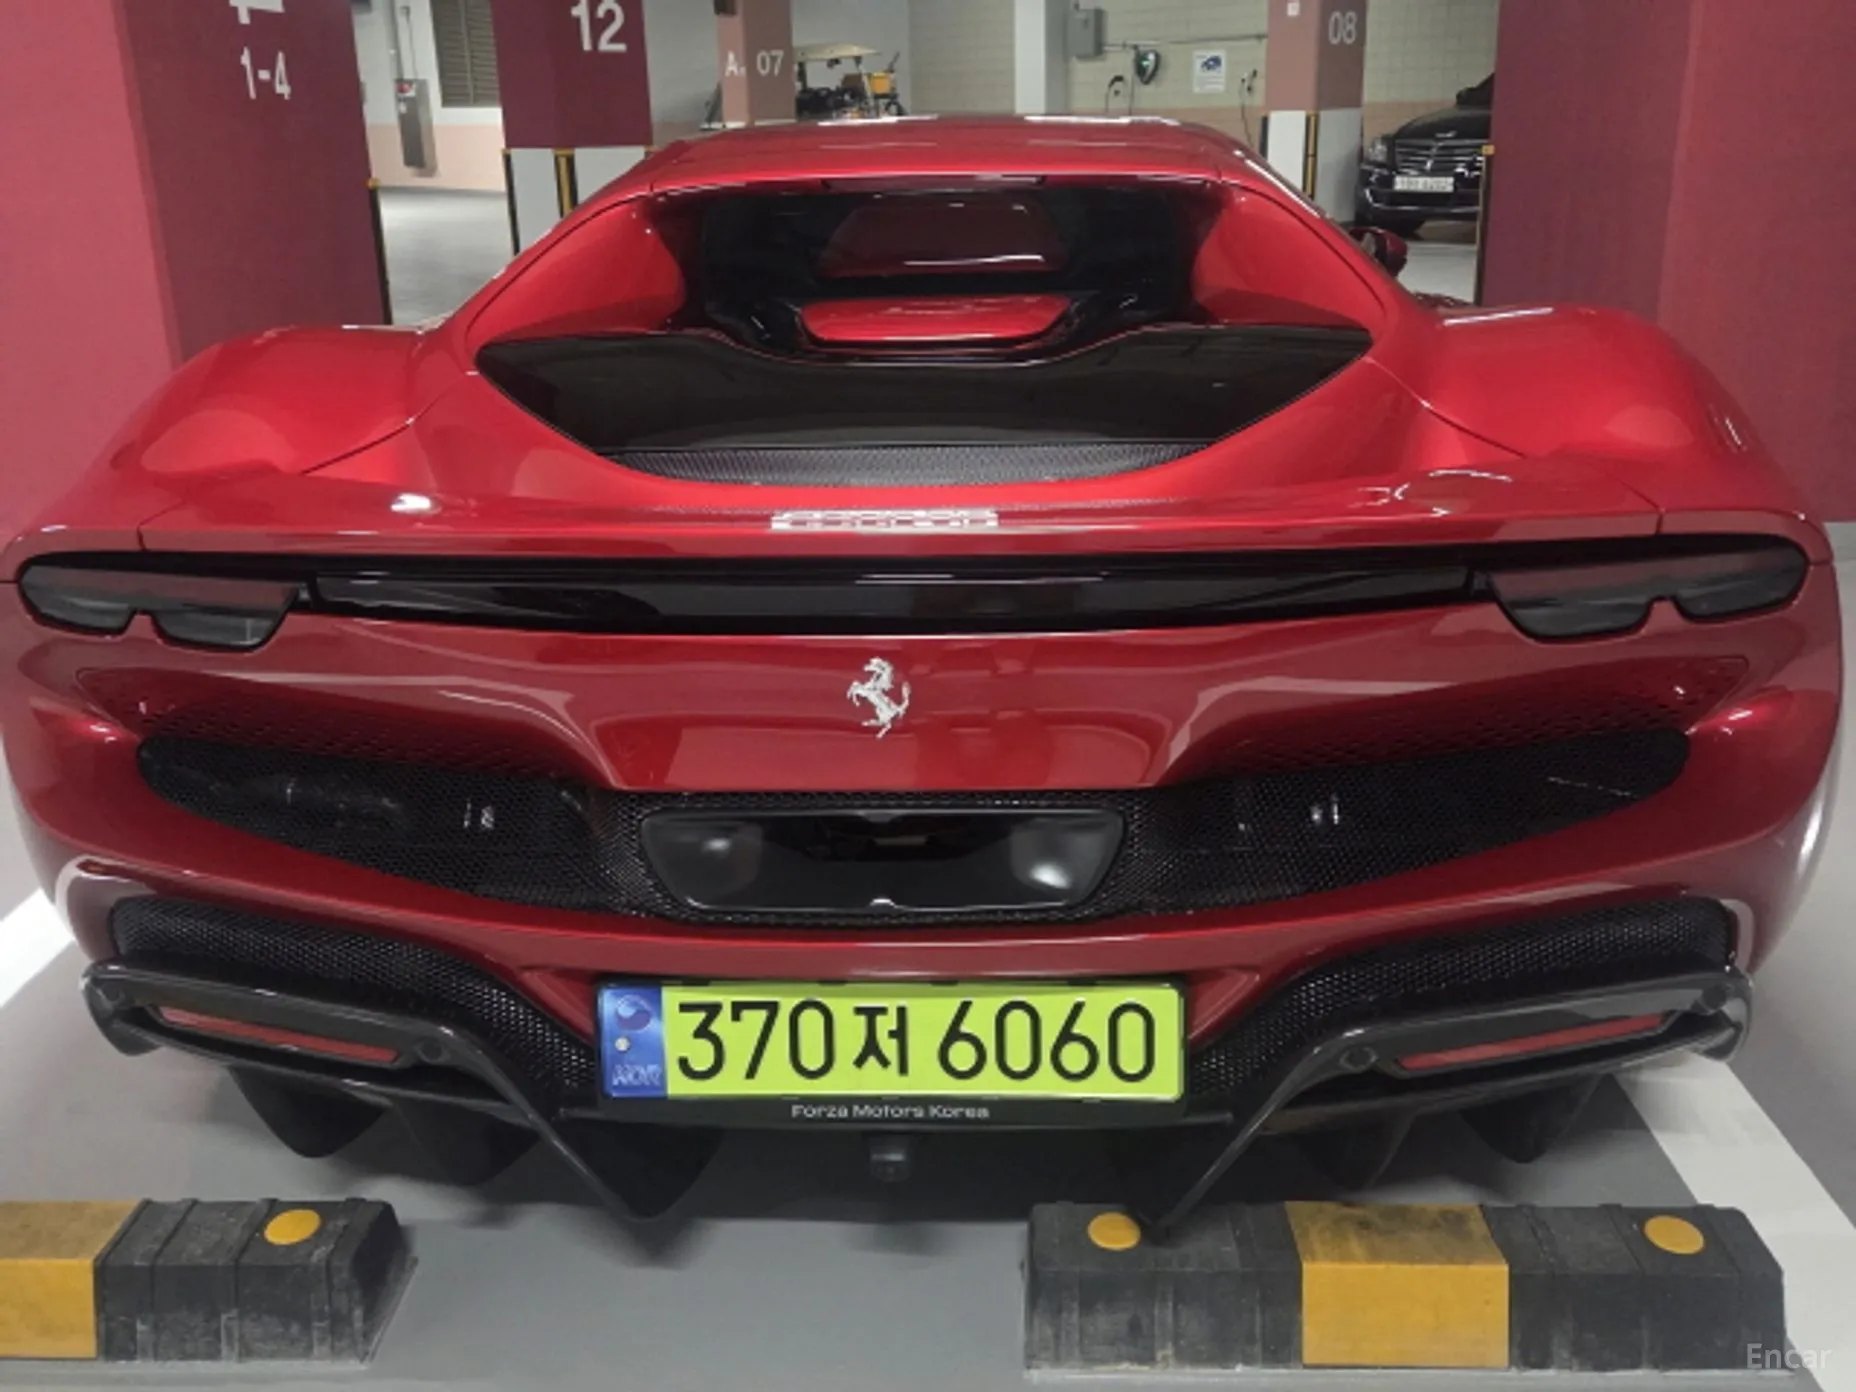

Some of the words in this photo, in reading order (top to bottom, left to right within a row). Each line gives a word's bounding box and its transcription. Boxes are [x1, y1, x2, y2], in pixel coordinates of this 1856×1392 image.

[571, 0, 627, 51] 12
[1328, 11, 1357, 45] 08
[240, 46, 292, 100] 1-4
[756, 50, 784, 77] 07
[938, 1000, 1156, 1082] 6060
[791, 1105, 848, 1118] Forza
[853, 1105, 924, 1118] Motors
[928, 1105, 989, 1118] Korea
